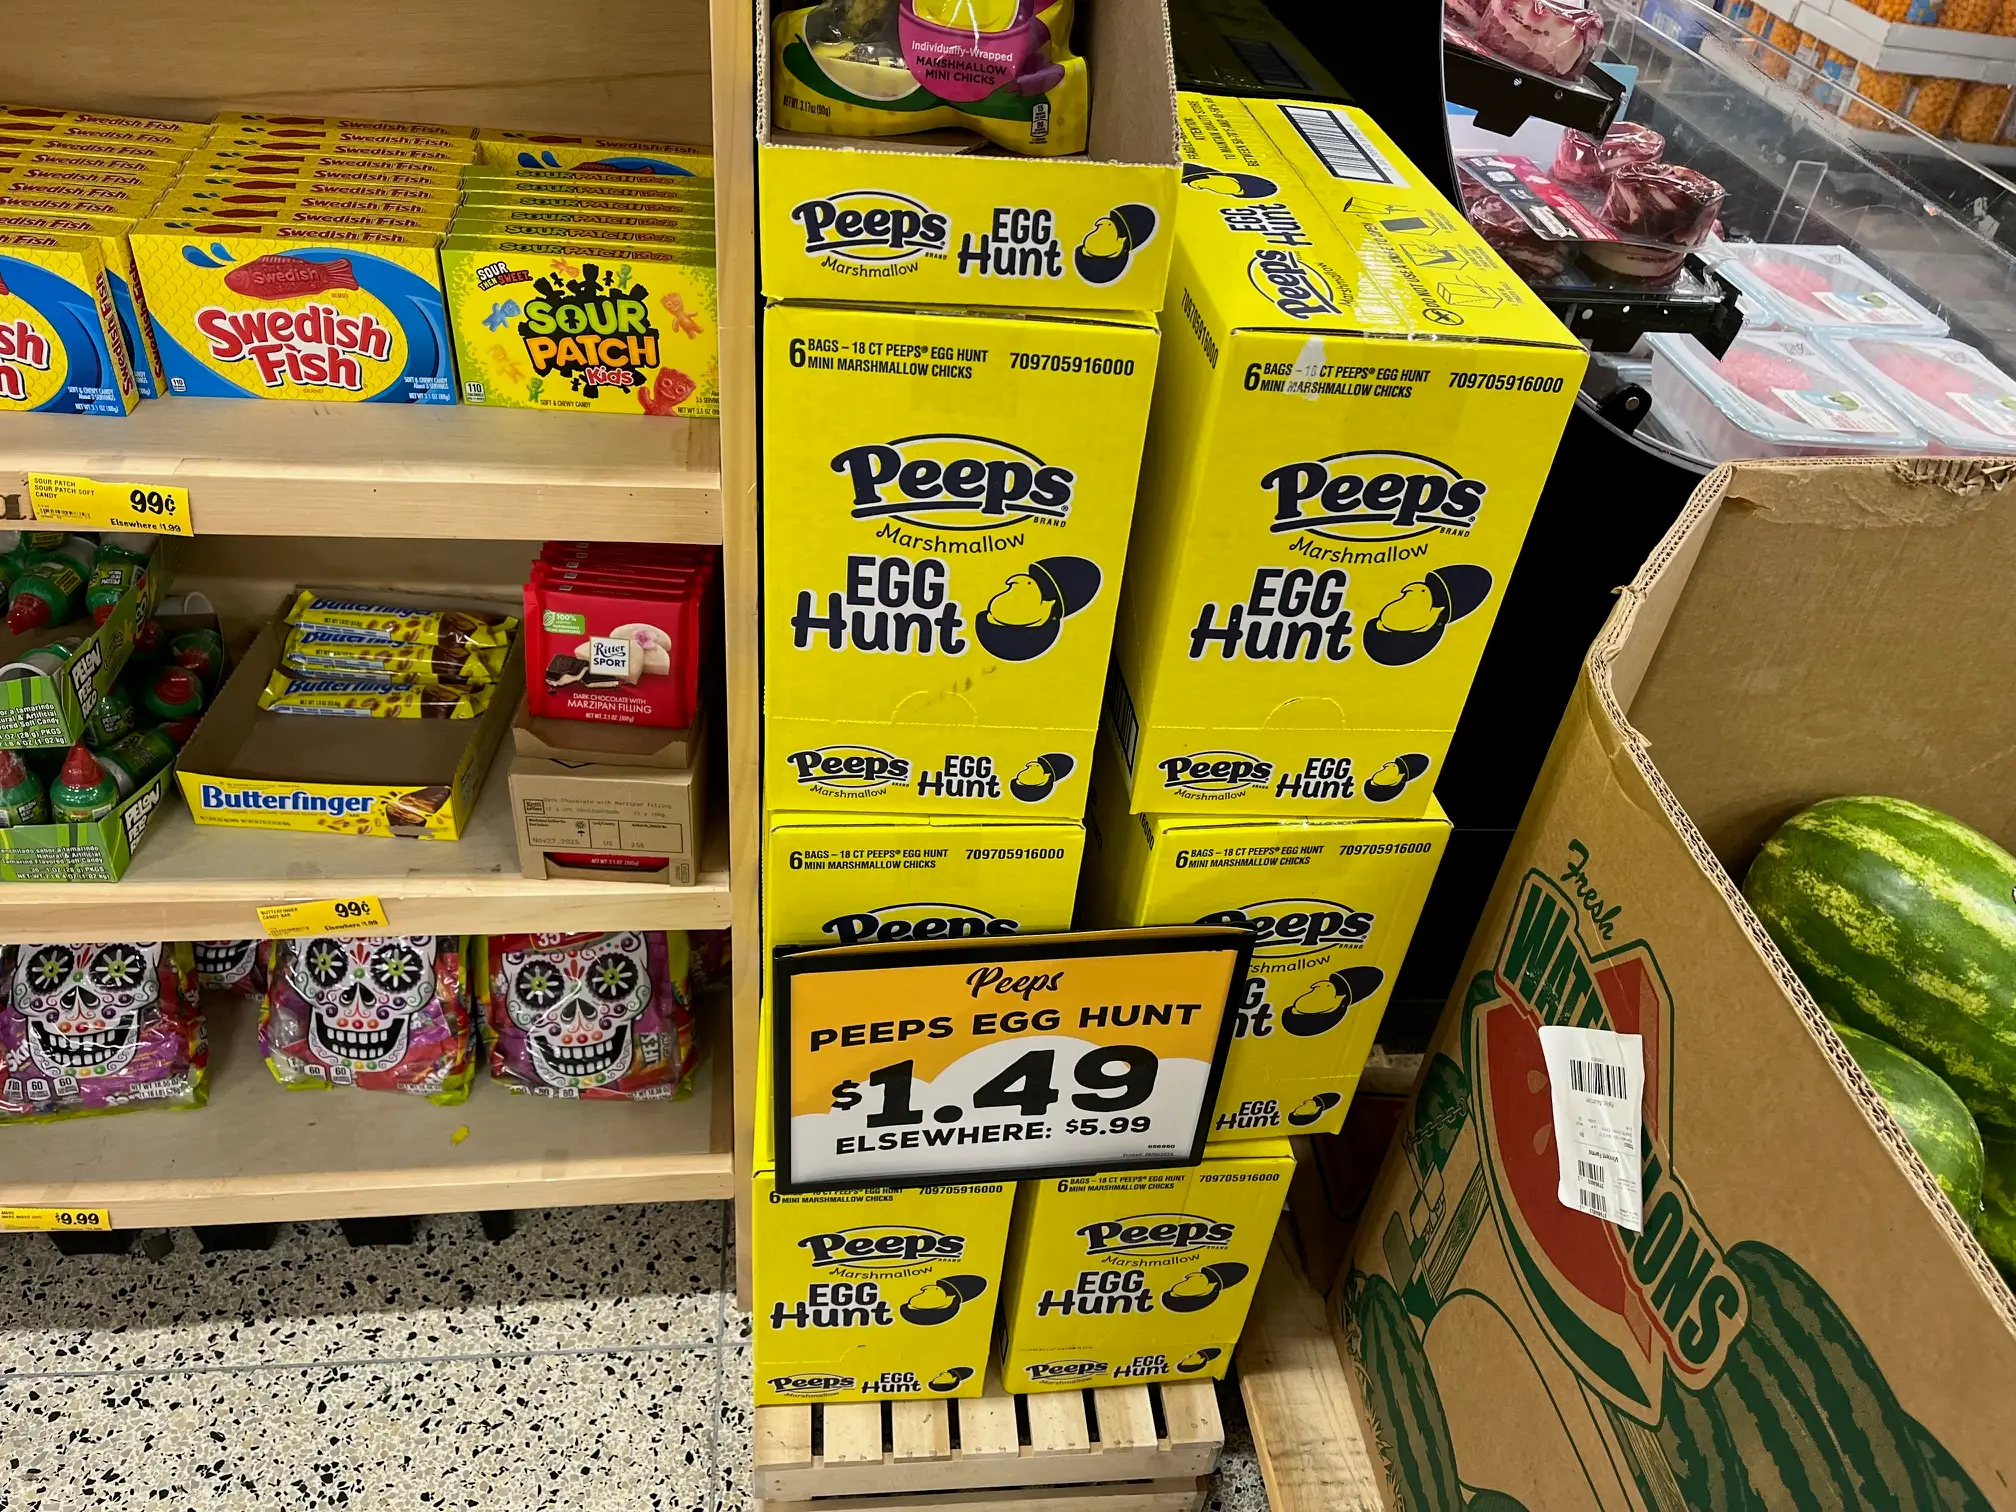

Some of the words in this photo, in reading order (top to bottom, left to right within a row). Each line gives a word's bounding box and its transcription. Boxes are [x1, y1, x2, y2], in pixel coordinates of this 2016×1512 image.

[911, 40, 1013, 62] Individually-Wrapped
[916, 55, 1007, 77] MARSHMALLOW
[925, 68, 951, 82] MINI
[953, 70, 995, 85] CHICKS
[74, 114, 142, 128] Swedish
[143, 121, 182, 132] Fish
[596, 140, 661, 151] Swedish
[663, 145, 699, 155] Fish
[792, 200, 947, 248] Peeps
[992, 207, 1052, 245] EGG
[1219, 207, 1269, 232] EGG
[1248, 203, 1313, 246] Hunt
[277, 227, 359, 241] Swedish
[362, 232, 405, 243] Fish
[500, 242, 563, 255] SOUR
[563, 246, 631, 259] PATCH
[924, 252, 948, 261] BRAND
[957, 233, 1063, 277] Hunt
[253, 267, 321, 284] Swedish
[477, 262, 508, 282] SOUR
[821, 256, 918, 278] Marshmallow
[479, 278, 498, 292] THEN
[1255, 249, 1331, 320] Peeps
[526, 299, 647, 335] SOUR
[198, 305, 388, 358] Swedish
[525, 336, 657, 370] PATCH
[788, 338, 806, 368] 6
[808, 339, 839, 354] BAGS
[852, 341, 866, 355] 18
[868, 342, 884, 356] CT
[930, 346, 954, 361] EGG
[956, 347, 988, 363] HUNT
[251, 345, 359, 390] Fish
[807, 356, 834, 371] MINI
[837, 358, 929, 377] MARSHMALLOW
[931, 364, 973, 379] CHICKS
[1009, 352, 1135, 377] 709705916000
[586, 367, 634, 386] Kids
[1244, 363, 1261, 391] 6
[1264, 363, 1293, 376] BAGS
[1320, 366, 1334, 378] CT
[1377, 368, 1398, 381] EGG
[1400, 369, 1430, 383] HUNT
[1448, 372, 1563, 394] 709705916000
[468, 383, 482, 394] 110
[1260, 380, 1284, 393] MINI
[1287, 381, 1372, 397] MARSHMALLOW
[1374, 385, 1413, 399] CHICKS
[34, 477, 53, 486] SOUR
[54, 479, 76, 487] PATCH
[34, 484, 53, 493] SOUR
[54, 486, 77, 495] PATCH
[78, 488, 95, 496] SOFT
[830, 444, 1074, 515] Peeps
[35, 491, 58, 499] CANDY
[130, 489, 176, 516] 99¢
[1261, 461, 1487, 527] Peeps
[110, 518, 158, 531] Elsewhere
[1033, 516, 1067, 529] BRAND
[1439, 526, 1470, 538] BRAND
[876, 522, 1025, 555] Marshmallow
[1289, 535, 1429, 565] Marshmallow
[847, 555, 946, 609] EGG
[1247, 567, 1347, 619] EGG
[556, 614, 577, 622] 100%
[791, 590, 967, 655] Hunt
[1189, 603, 1353, 662] Hunt
[593, 642, 625, 657] Ritter
[593, 657, 626, 668] SPORT
[284, 678, 413, 696] Butterfinger
[567, 700, 616, 711] MARZIPAN
[618, 703, 651, 714] FILLING
[590, 694, 629, 704] CHOCOLATE
[787, 750, 910, 781] Peeps
[944, 755, 992, 778] EGG
[1158, 757, 1274, 785] Peeps
[1304, 757, 1352, 780] EGG
[809, 784, 888, 799] Marshmallow
[917, 770, 1001, 799] Hunt
[1173, 788, 1247, 802] Marshmallow
[1275, 773, 1354, 799] Hunt
[202, 785, 375, 816] Butterfinger
[789, 850, 803, 870] 6
[804, 849, 829, 859] BAGS
[839, 849, 851, 859] 18
[853, 849, 864, 859] CT
[903, 849, 921, 859] EGG
[923, 848, 948, 858] HUNT
[965, 848, 1065, 860] 709705916000
[1339, 842, 1431, 856] 709705916000
[804, 860, 825, 870] MINI
[827, 859, 901, 870] MARSHMALLOW
[903, 859, 936, 869] CHICKS
[1560, 839, 1624, 942] Fresh
[335, 901, 371, 918] 99¢
[324, 923, 360, 931] Elsewhere
[966, 966, 1065, 1001] Peeps
[810, 1014, 954, 1052] PEEPS
[972, 1008, 1061, 1036] EGG
[1079, 1002, 1203, 1029] HUNT
[32, 1082, 43, 1091] 60
[59, 1077, 72, 1087] 60
[831, 1044, 1159, 1129] $1.49
[835, 1122, 1053, 1156] ELSEWHERE:
[1065, 1115, 1152, 1136] $5.99
[1199, 1173, 1280, 1184] 709705916000
[919, 1185, 1003, 1196] 709705916000
[55, 1213, 99, 1225] $9.99
[1077, 1221, 1236, 1249] Peeps
[797, 1233, 966, 1260] Peeps
[1077, 1269, 1145, 1295] EGG
[809, 1282, 878, 1308] EGG
[1037, 1290, 1154, 1317] Hunt
[770, 1301, 894, 1330] Hunt
[1026, 1361, 1109, 1381] Peeps
[1113, 1363, 1169, 1379] Hunt
[1132, 1354, 1165, 1368] EGG
